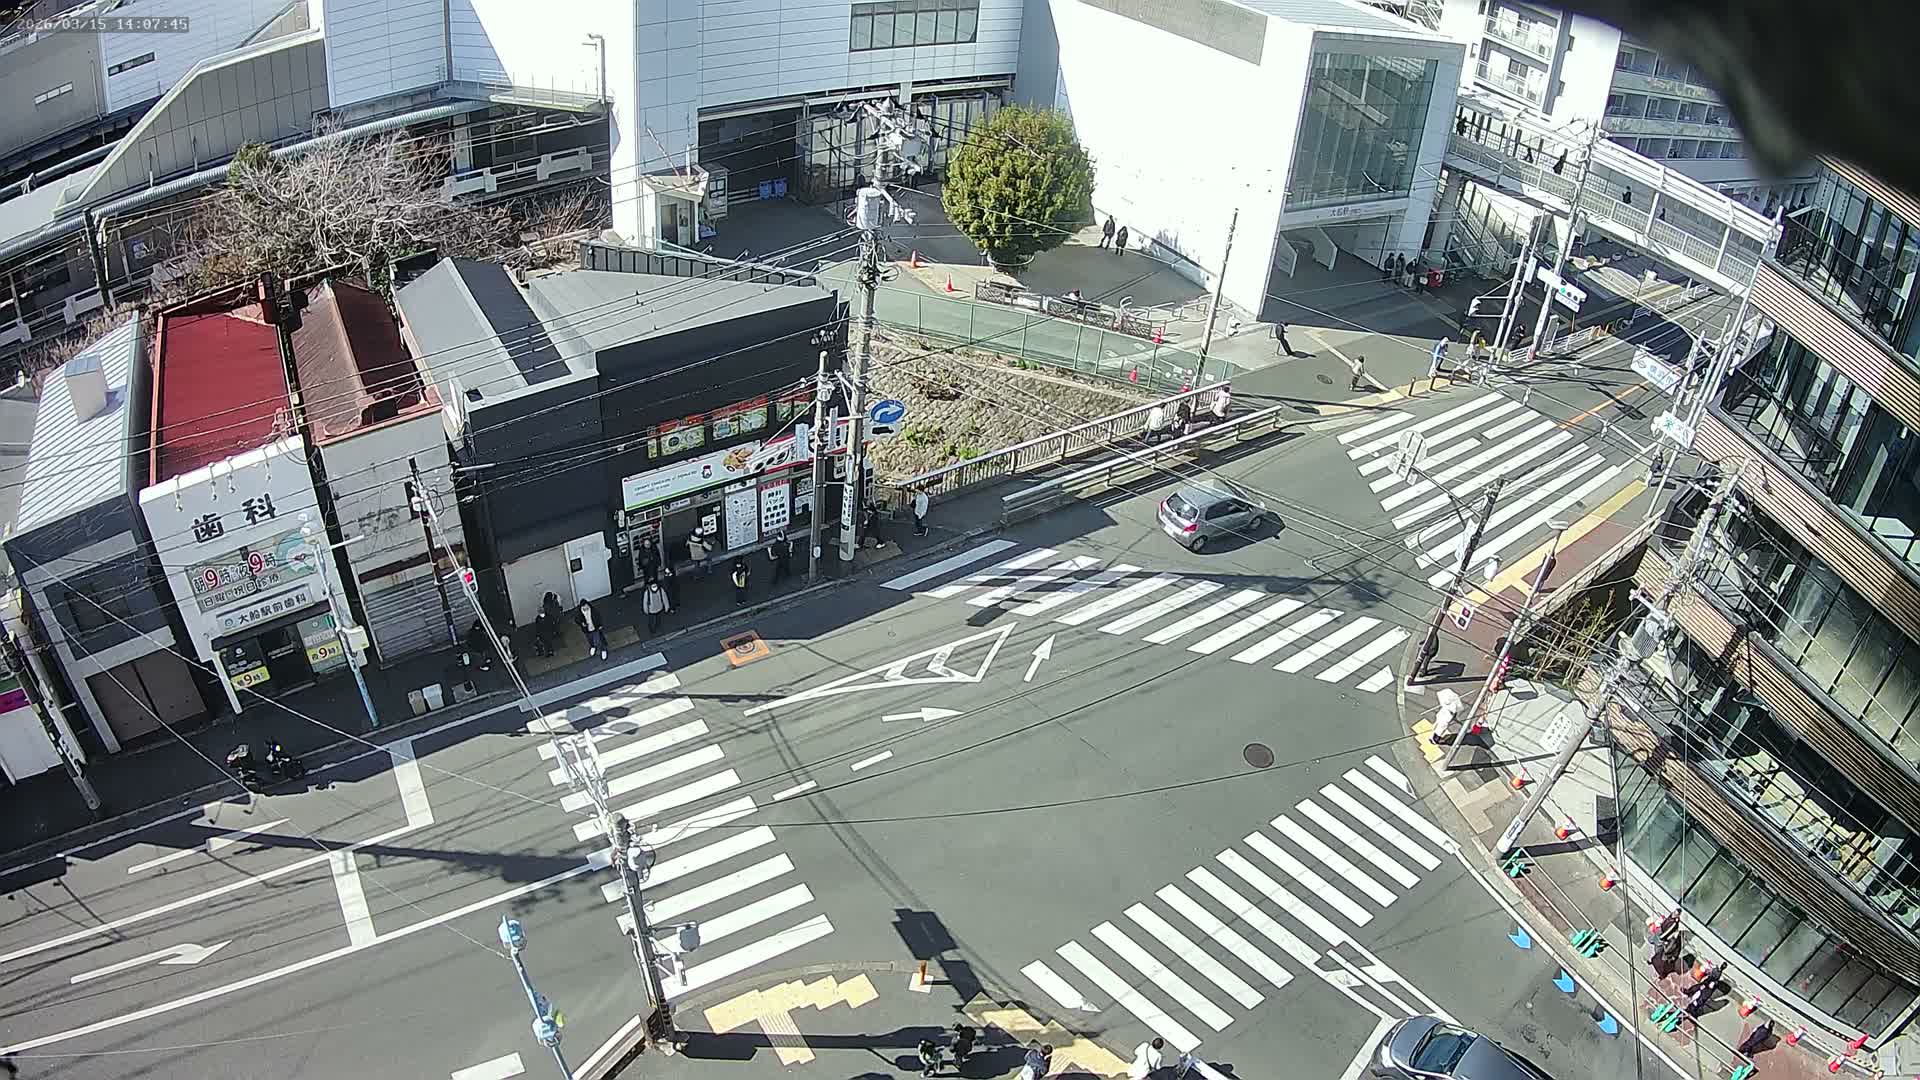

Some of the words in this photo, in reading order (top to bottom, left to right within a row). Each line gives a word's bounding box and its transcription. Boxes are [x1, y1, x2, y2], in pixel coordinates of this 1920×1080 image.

[191, 493, 276, 543] 歯科
[238, 593, 307, 624] 大船駅前歯科
